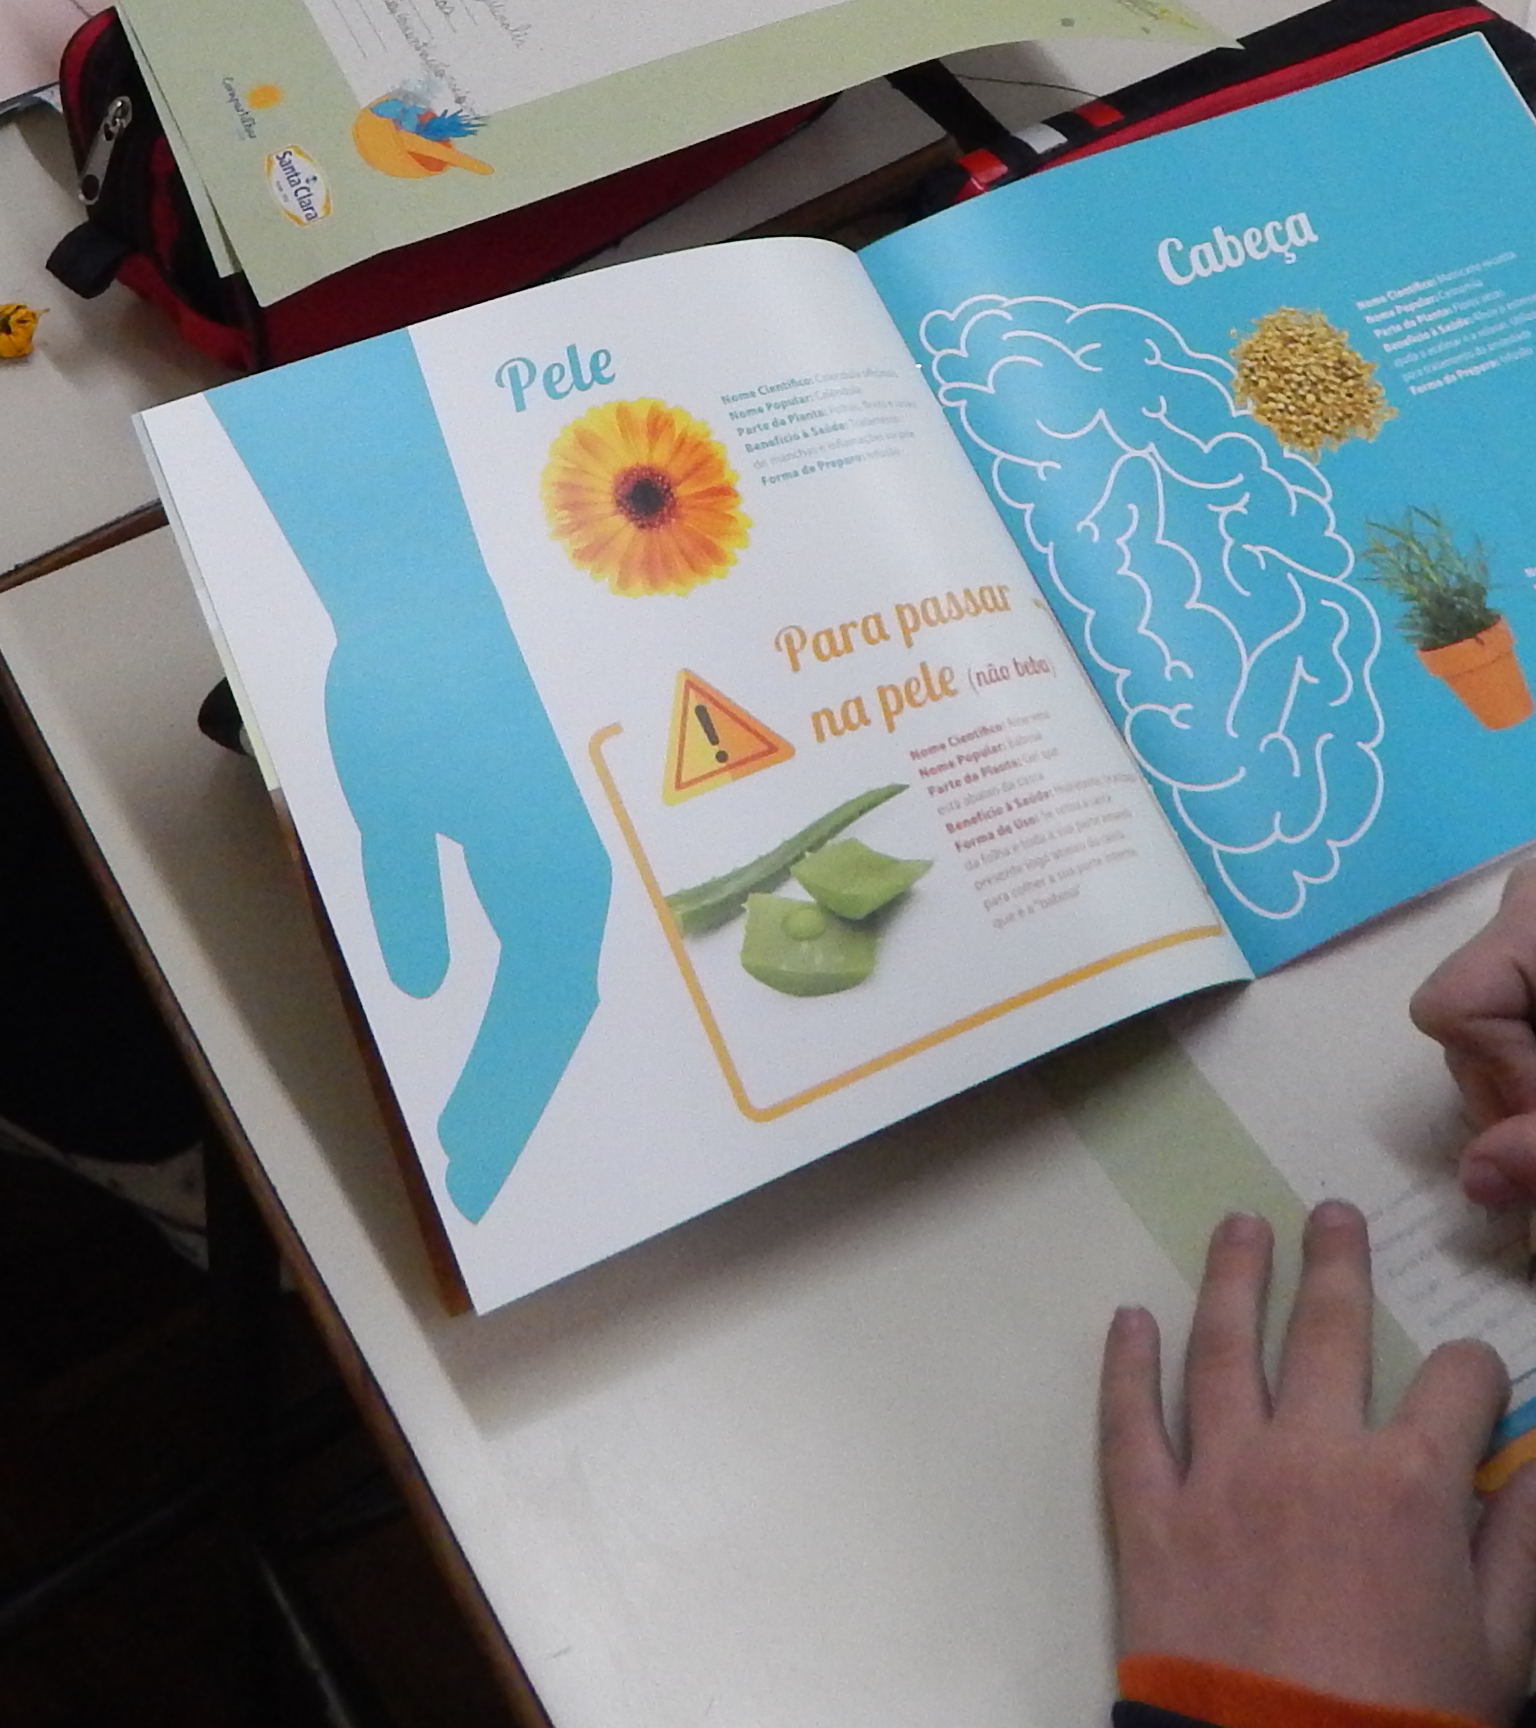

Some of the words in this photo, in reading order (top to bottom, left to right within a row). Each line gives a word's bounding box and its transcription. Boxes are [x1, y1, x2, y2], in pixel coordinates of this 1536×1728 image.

[276, 150, 309, 188] Santa
[293, 185, 318, 221] Clara
[1158, 212, 1318, 285] Cabeça
[495, 344, 616, 412] Pele
[774, 613, 891, 672] Para
[894, 583, 1012, 648] passar
[810, 697, 871, 743] na
[877, 661, 959, 733] pele
[968, 663, 1010, 695] (não
